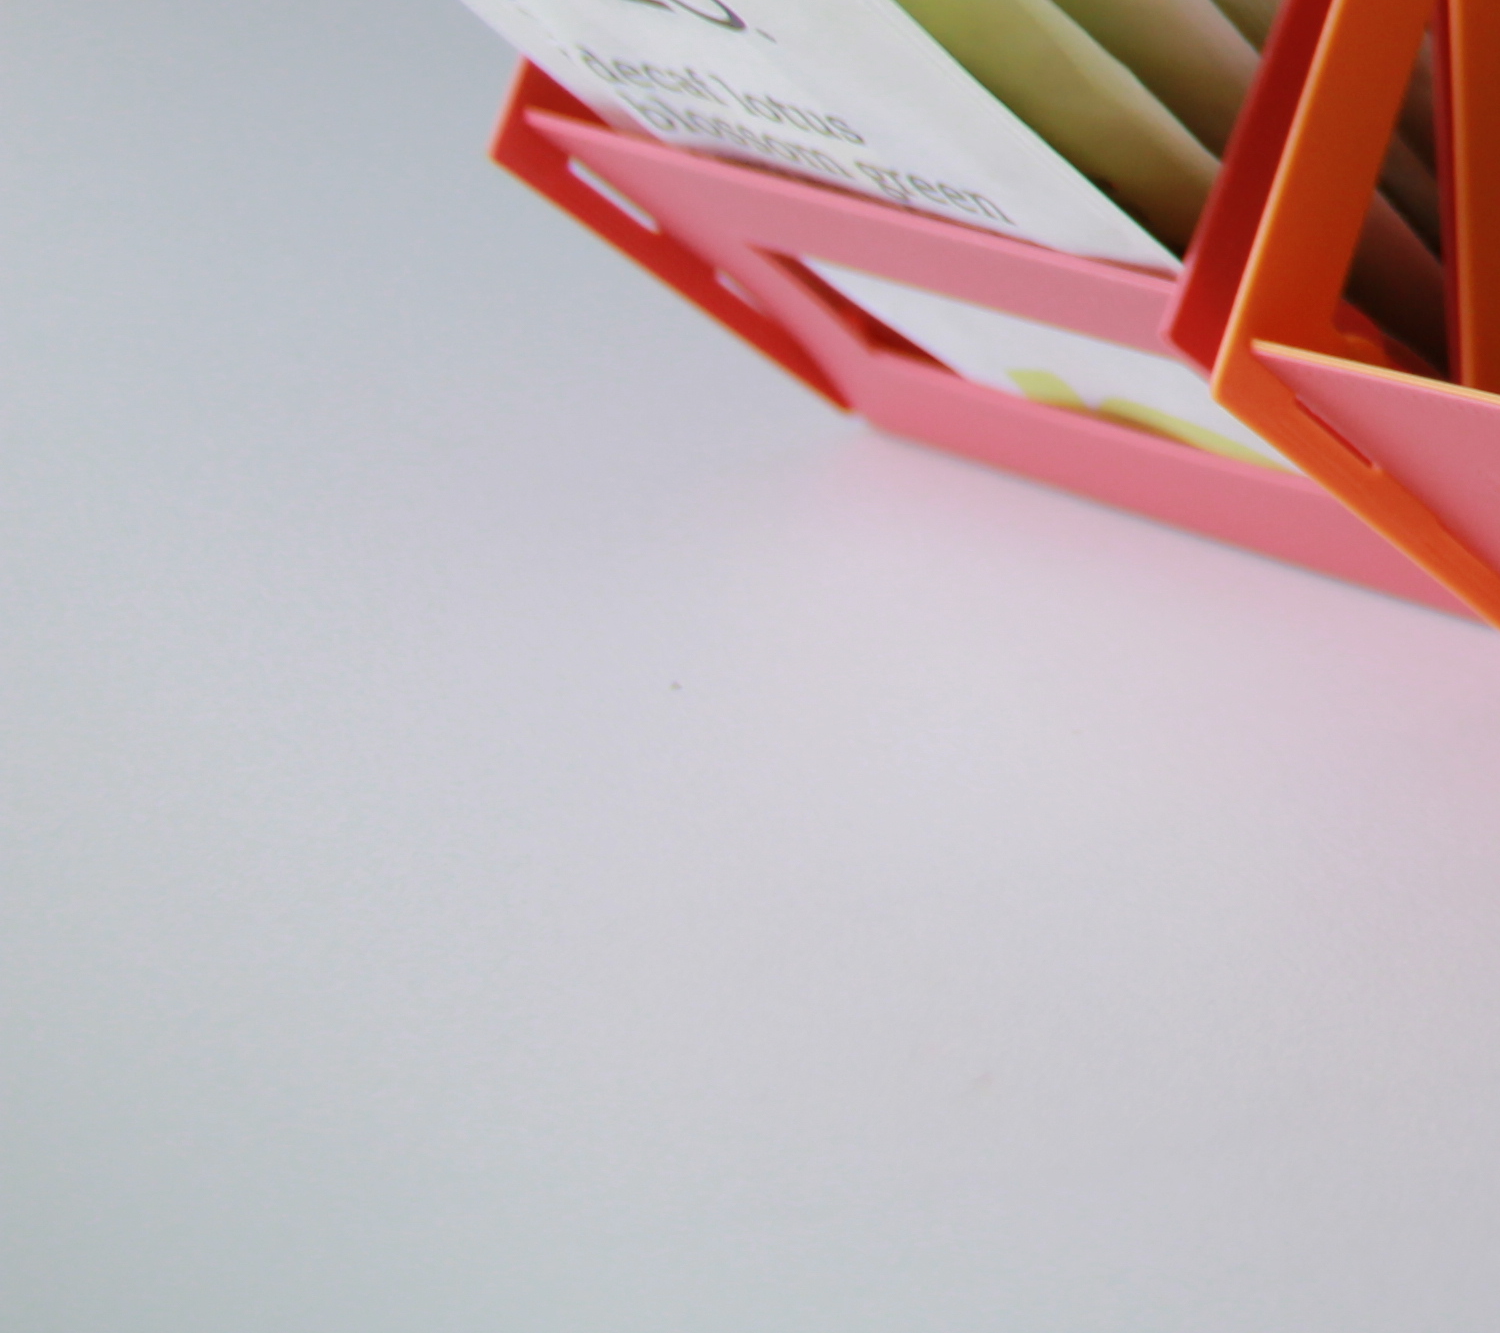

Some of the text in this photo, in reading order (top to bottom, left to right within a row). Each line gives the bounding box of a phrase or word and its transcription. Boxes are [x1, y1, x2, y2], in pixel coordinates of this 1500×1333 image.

[574, 44, 867, 146] decaf lotus
[613, 88, 1018, 227] blossom green
